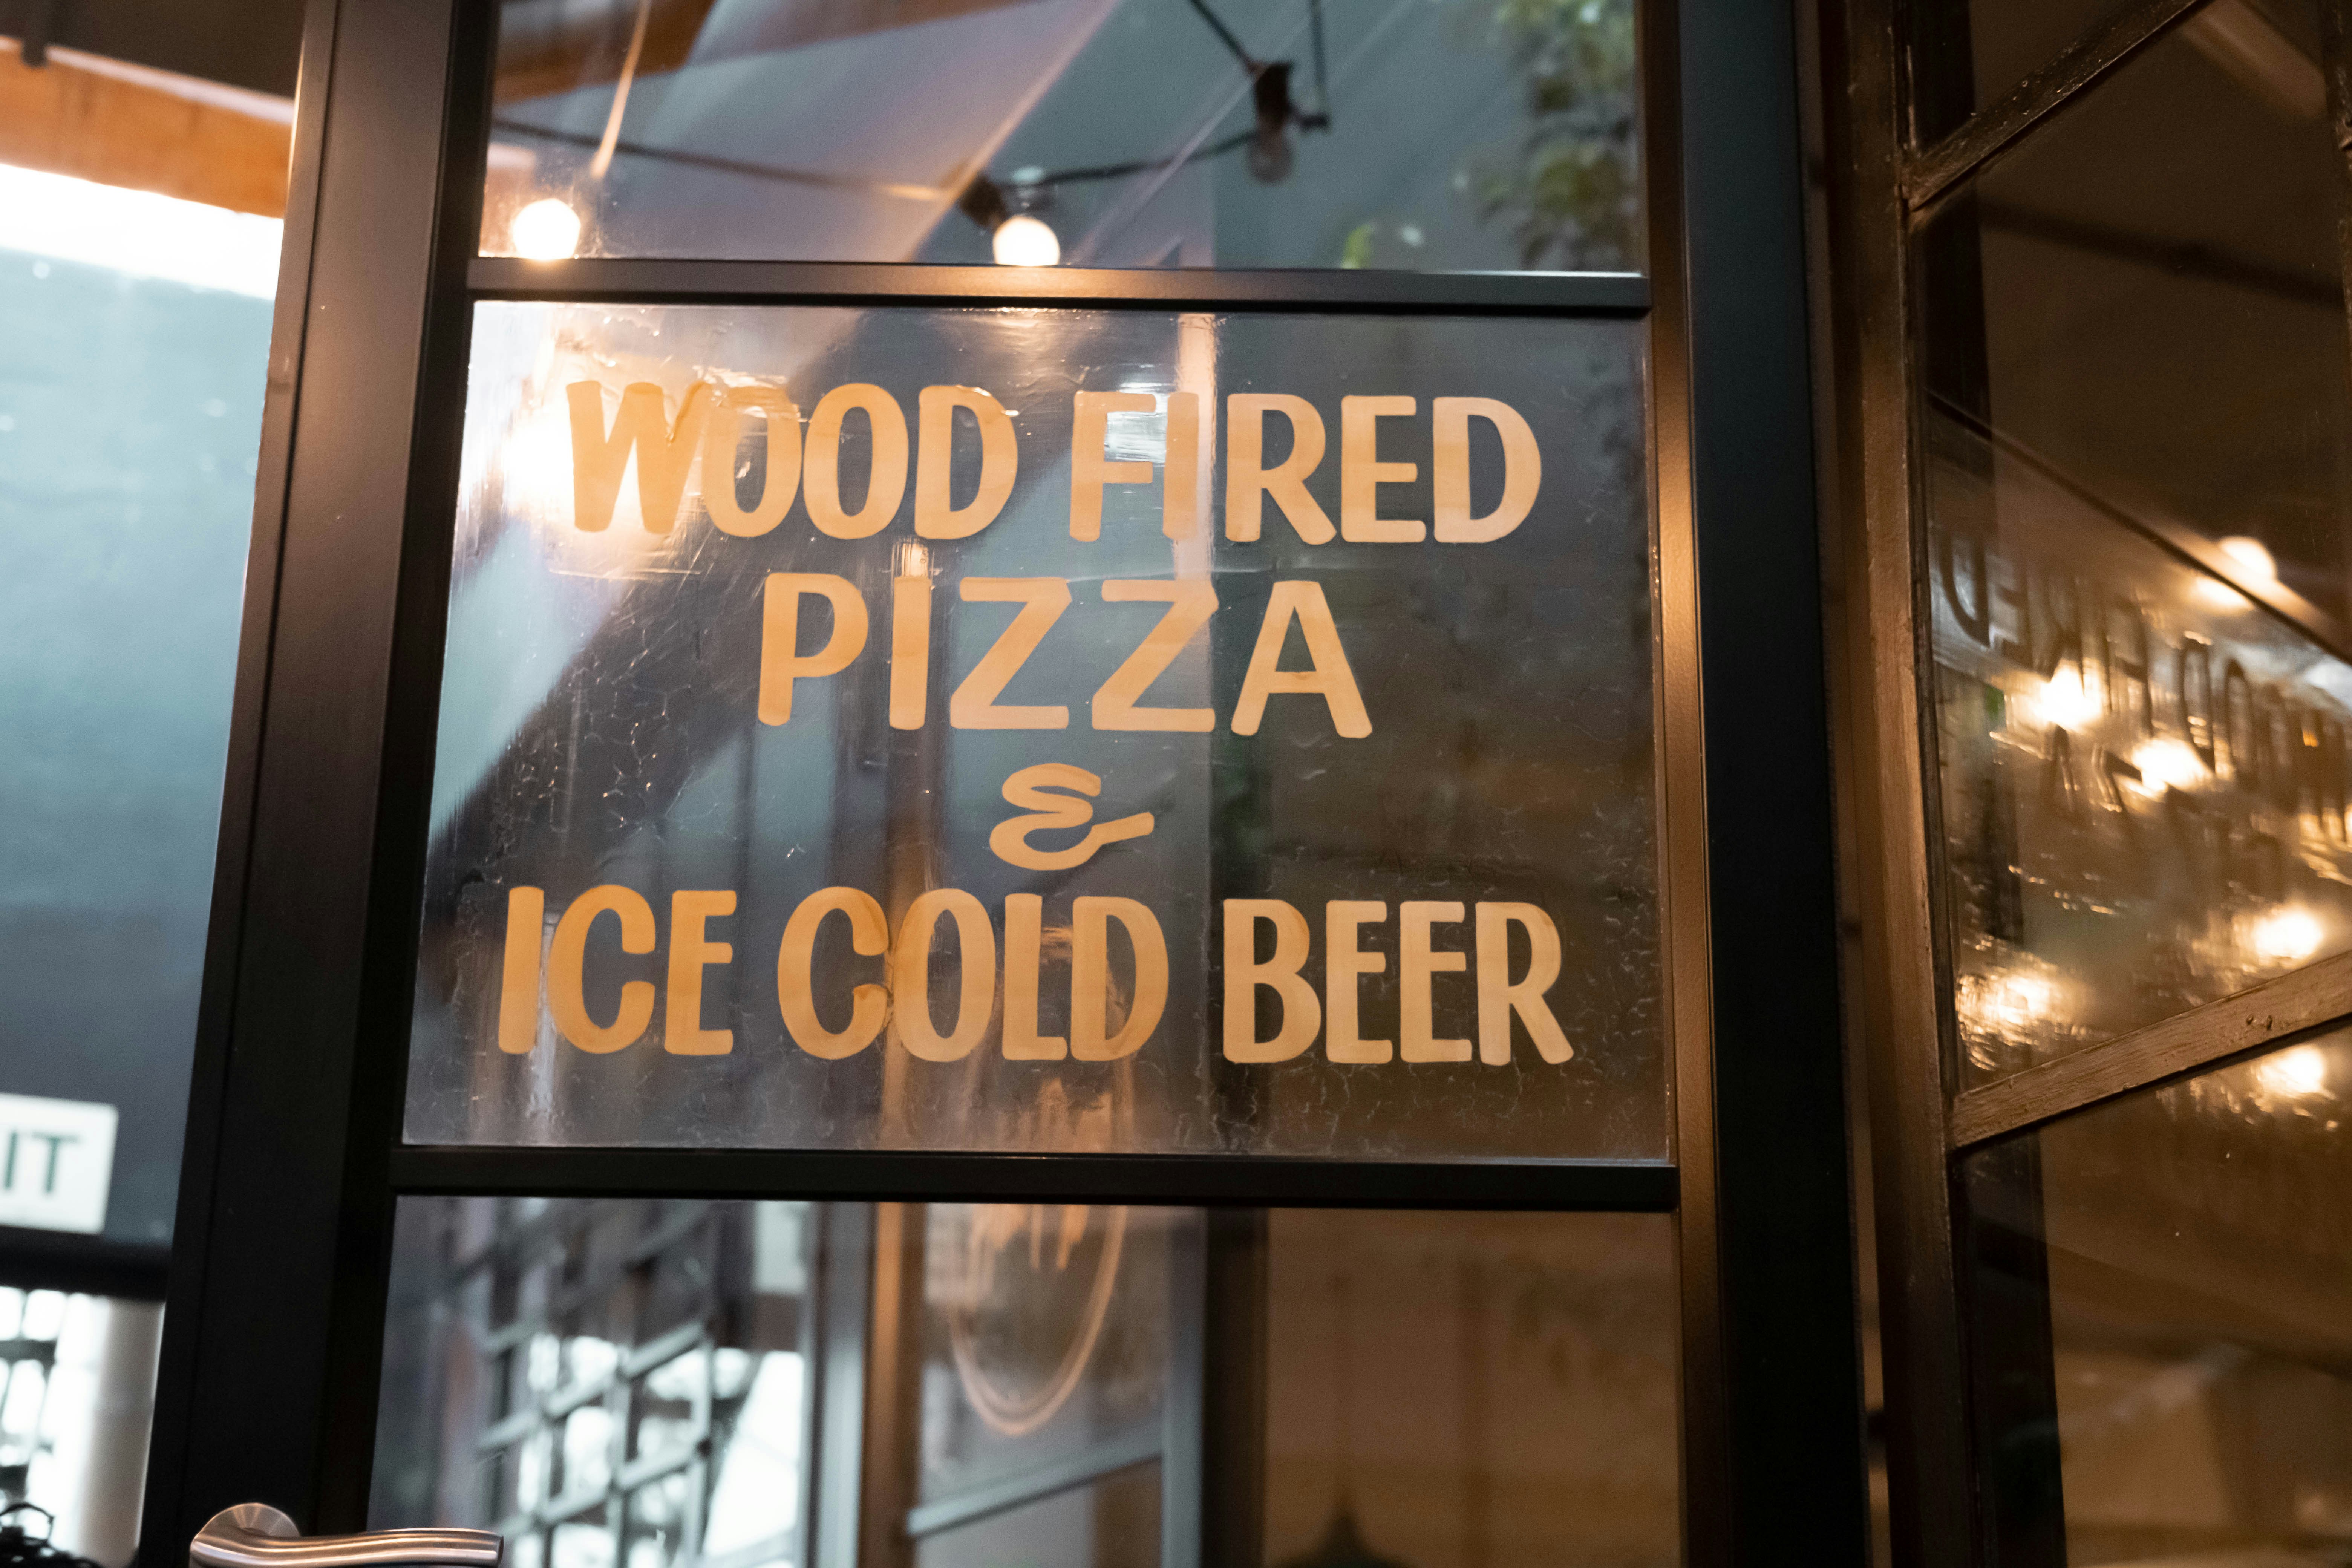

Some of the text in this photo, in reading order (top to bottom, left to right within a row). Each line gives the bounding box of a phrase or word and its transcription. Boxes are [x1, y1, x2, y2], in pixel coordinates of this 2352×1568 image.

[567, 382, 1542, 544] WOOD FIRED
[757, 572, 1373, 739] PIZZA
[989, 763, 1155, 871] &
[498, 884, 1574, 1066] ICE COLD BEER
